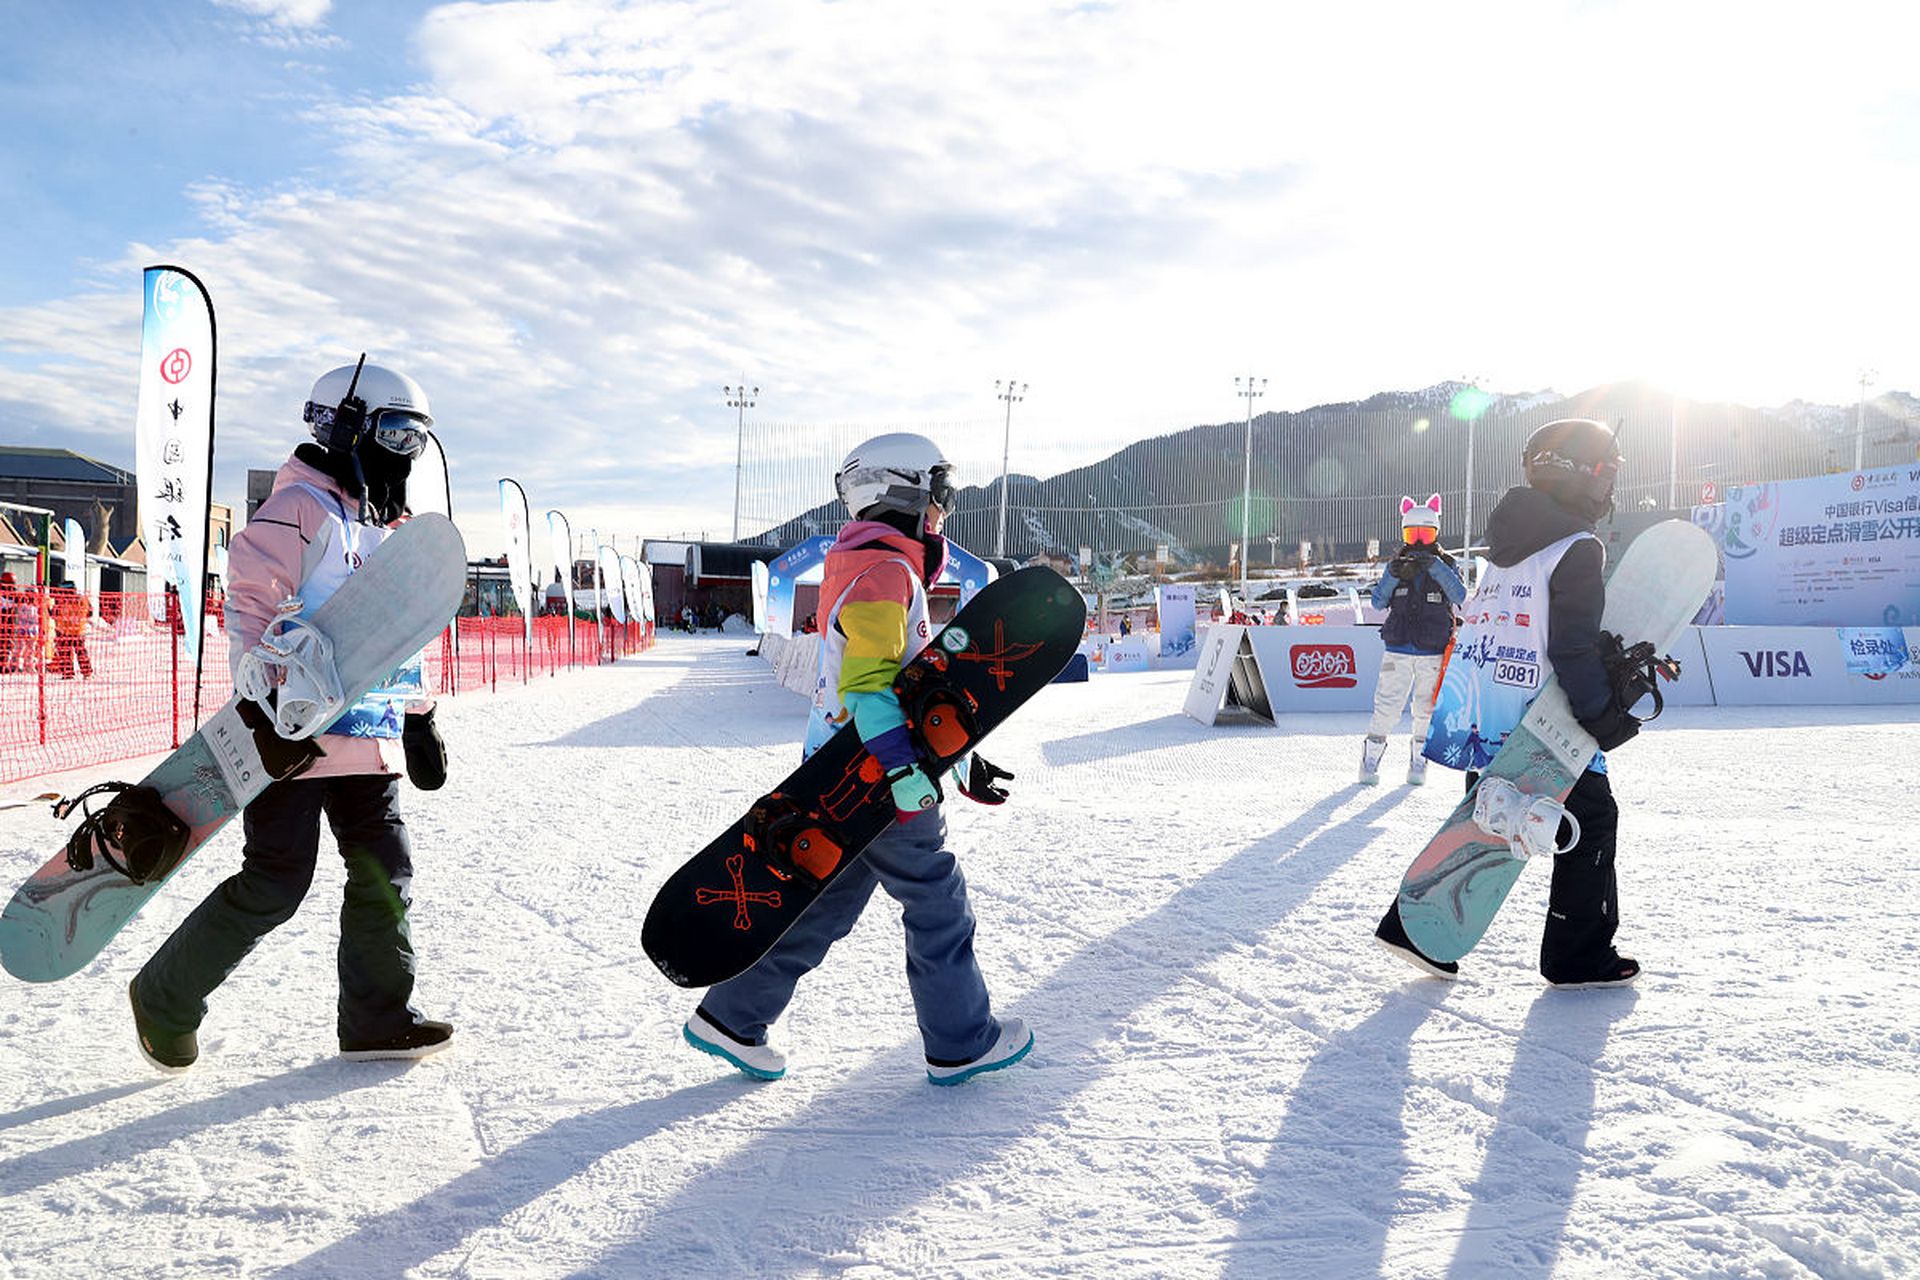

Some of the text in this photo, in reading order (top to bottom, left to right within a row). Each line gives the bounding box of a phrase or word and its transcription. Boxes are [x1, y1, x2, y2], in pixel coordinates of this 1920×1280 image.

[1825, 496, 1920, 519] 中国银行Visa信
[1511, 584, 1532, 599] VISA
[1849, 638, 1896, 657] 检录处
[1497, 663, 1536, 685] 3081
[1737, 651, 1812, 678] VISA
[1536, 716, 1580, 758] NITRO
[216, 726, 251, 782] NITRO
